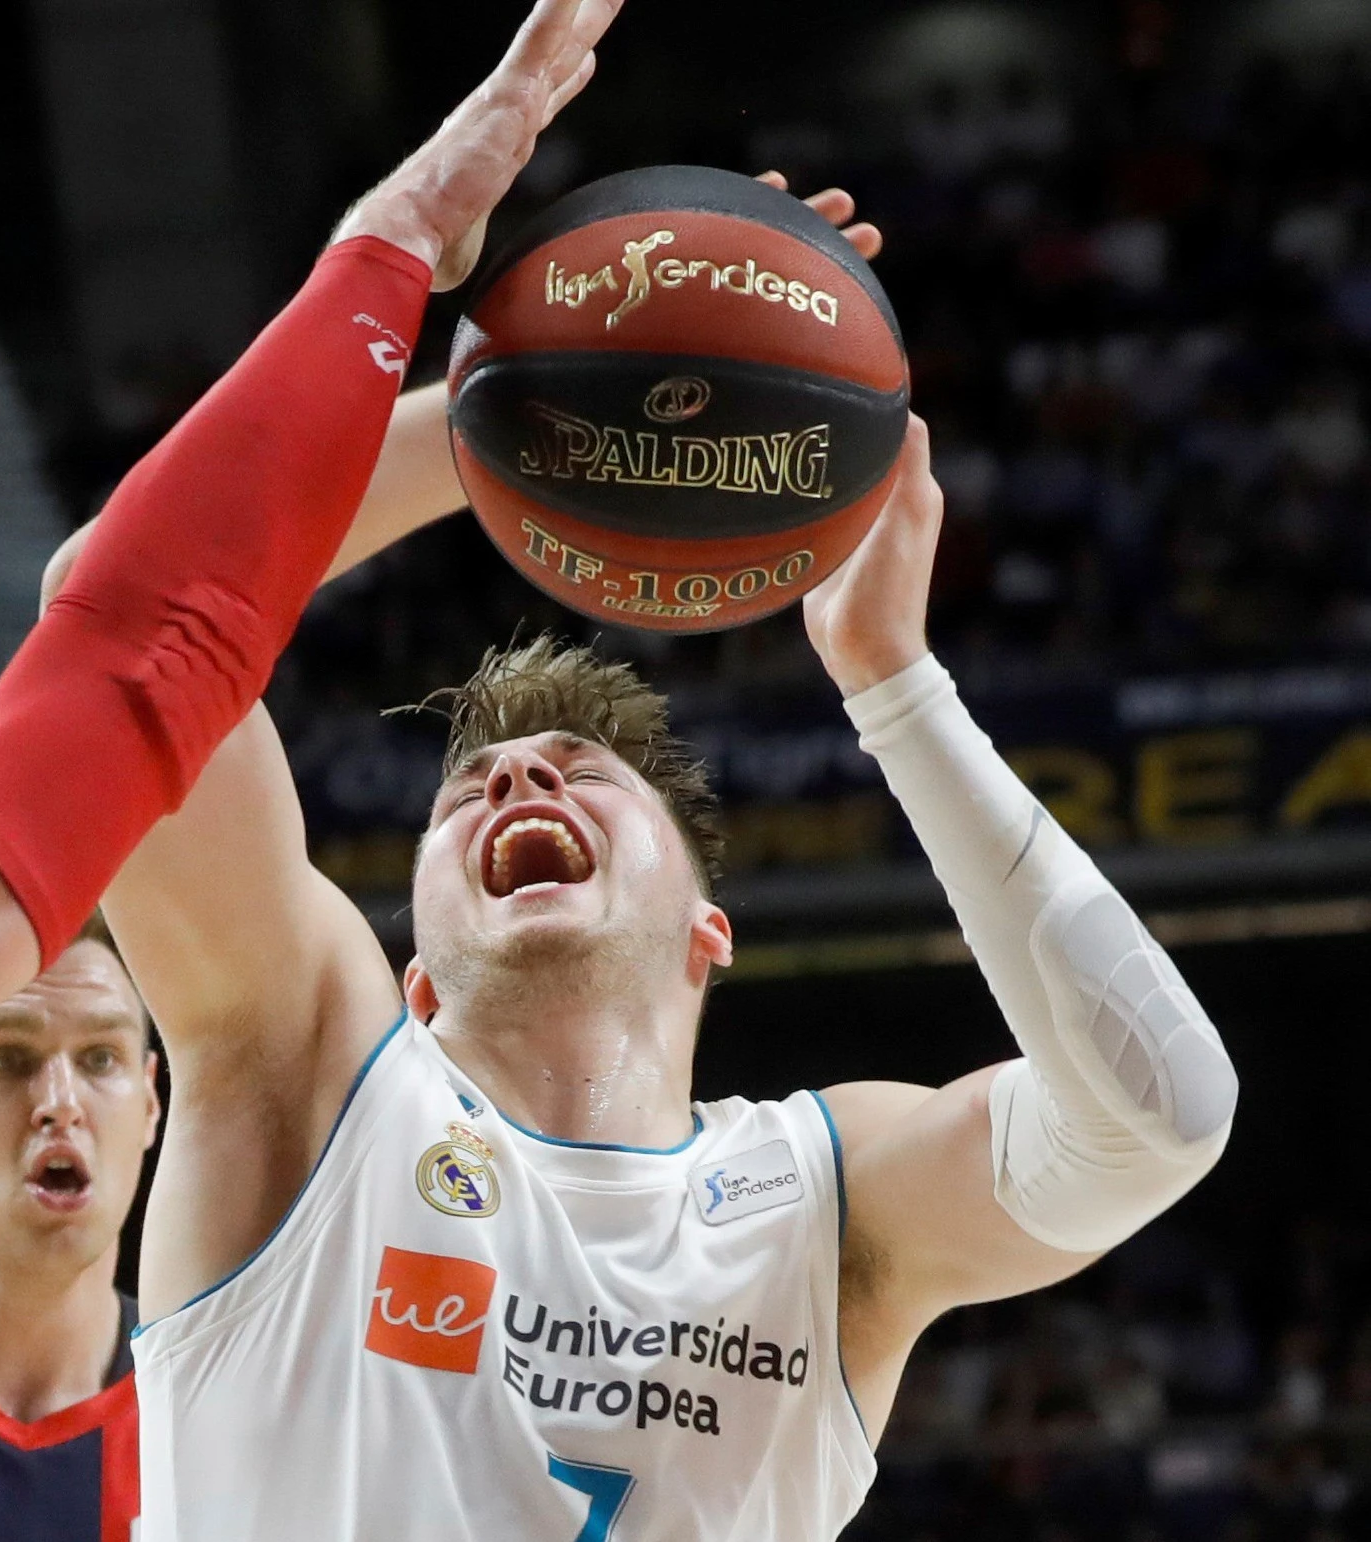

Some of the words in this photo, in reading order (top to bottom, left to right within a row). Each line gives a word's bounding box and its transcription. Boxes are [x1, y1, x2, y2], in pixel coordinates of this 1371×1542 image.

[545, 260, 618, 309] liga
[653, 258, 840, 327] endesa
[519, 404, 830, 499] SPALDING
[521, 519, 815, 603] TF-1000
[721, 1176, 749, 1190] liga
[727, 1173, 798, 1202] endesa
[504, 1294, 810, 1388] Universidad
[503, 1345, 721, 1437] Europea
